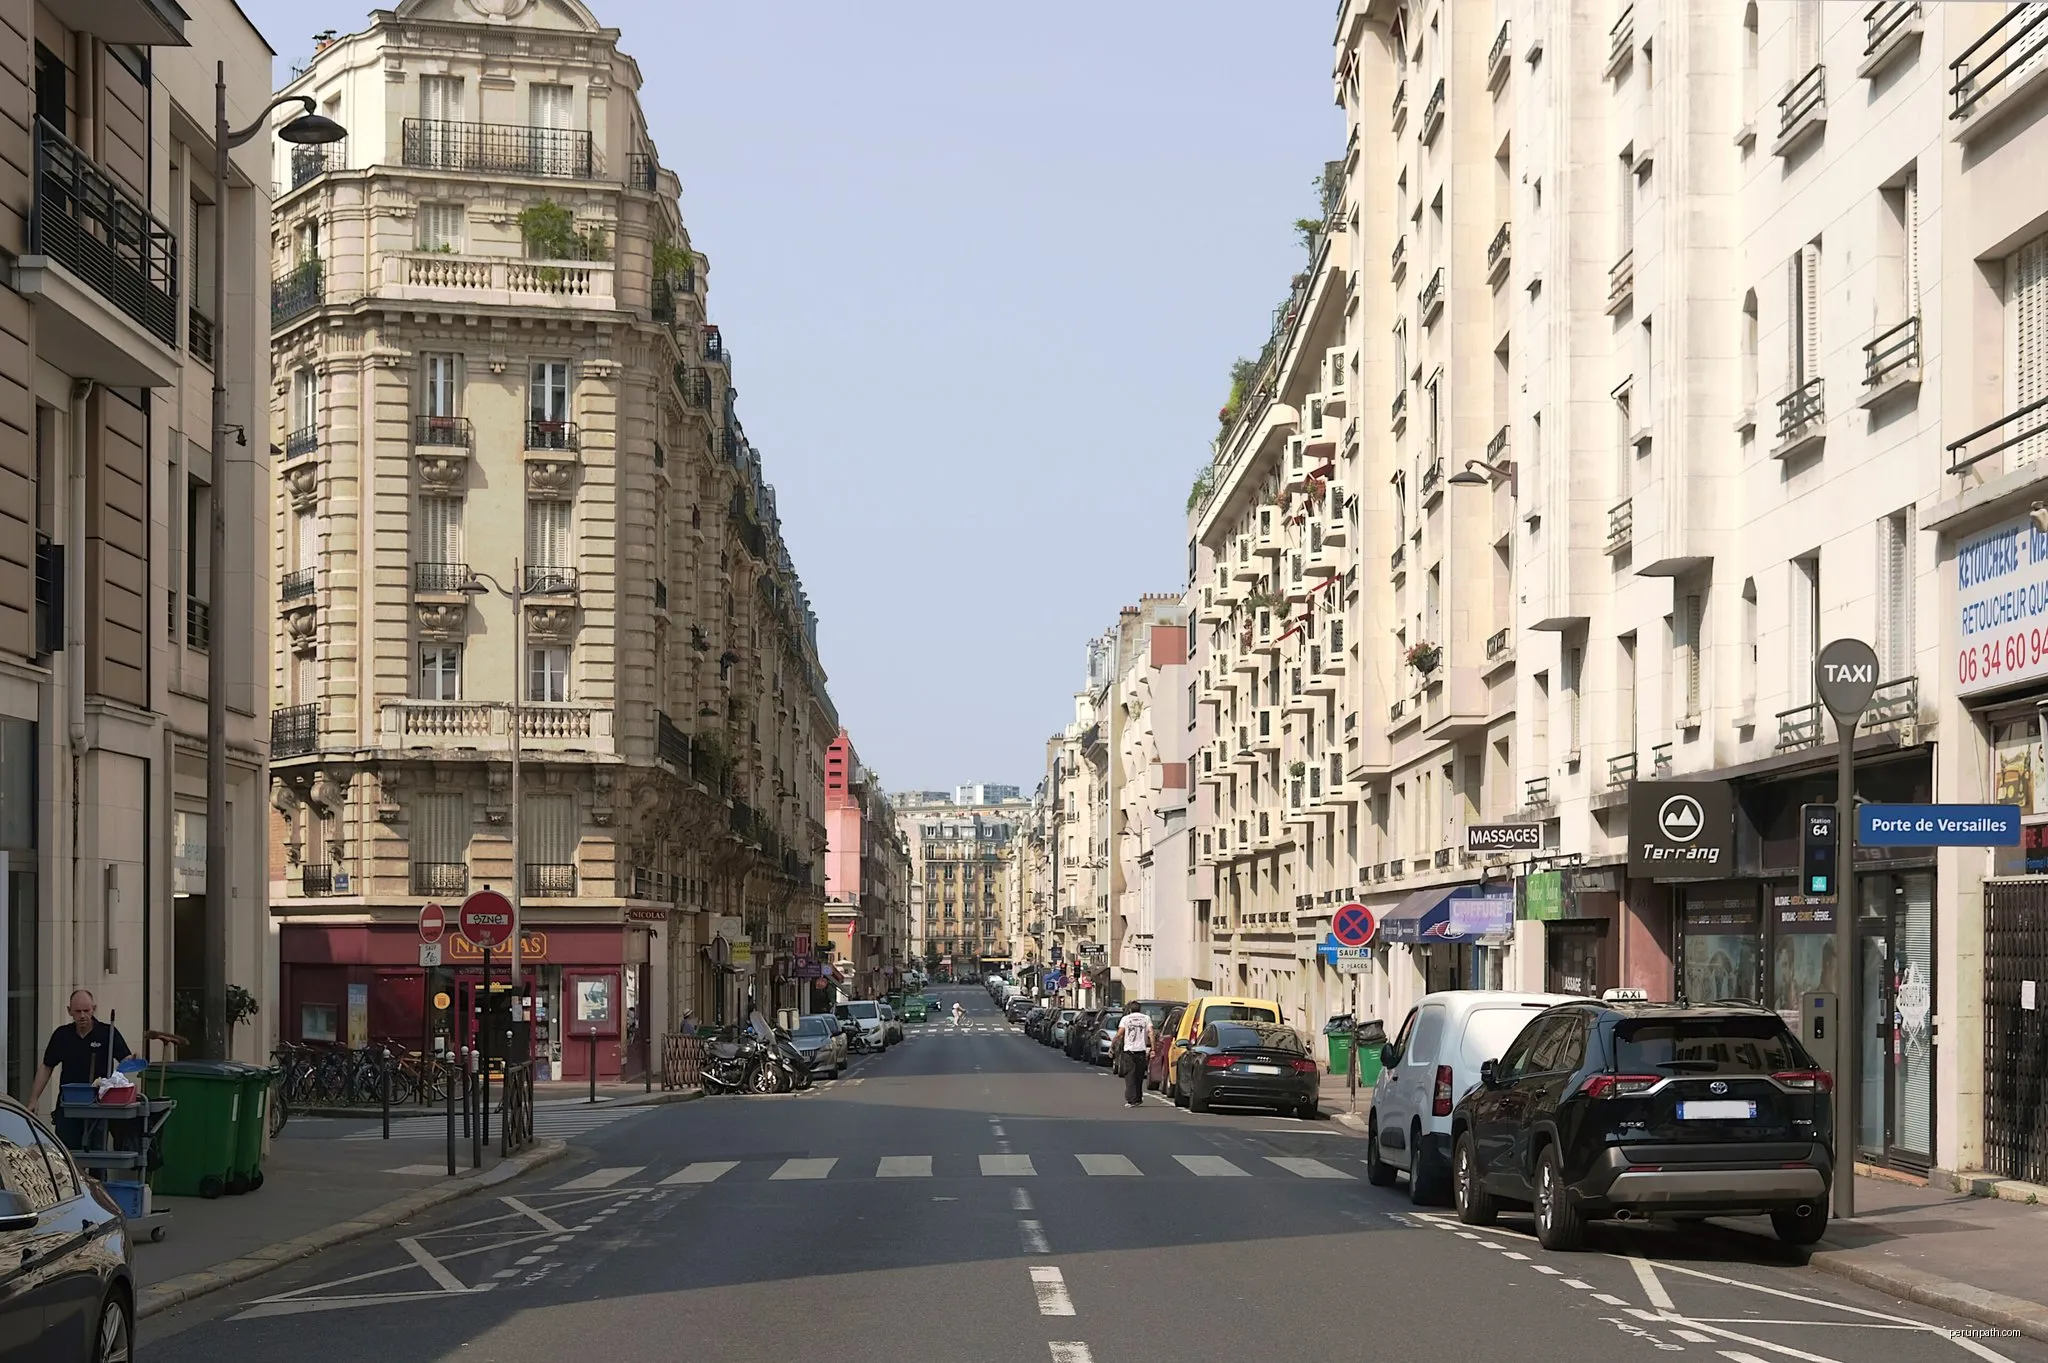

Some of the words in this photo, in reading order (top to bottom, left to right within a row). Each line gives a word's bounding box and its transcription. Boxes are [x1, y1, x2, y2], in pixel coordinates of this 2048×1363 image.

[1959, 527, 2019, 591] RETOUCHERIE
[1962, 587, 2027, 637] RETOUCHEUR
[1959, 647, 1977, 684] 06
[1982, 639, 2001, 678] 34
[2006, 632, 2026, 671] 60
[1823, 664, 1872, 683] TAXI
[1812, 824, 1828, 836] 64
[1871, 817, 1912, 832] Porte
[1915, 817, 1934, 832] de
[1937, 817, 2007, 832] Versailles
[1470, 827, 1538, 845] MASSAGES
[632, 911, 665, 919] NICOLAS
[1452, 900, 1503, 918] COIFFURE
[1616, 991, 1641, 999] TAXI
